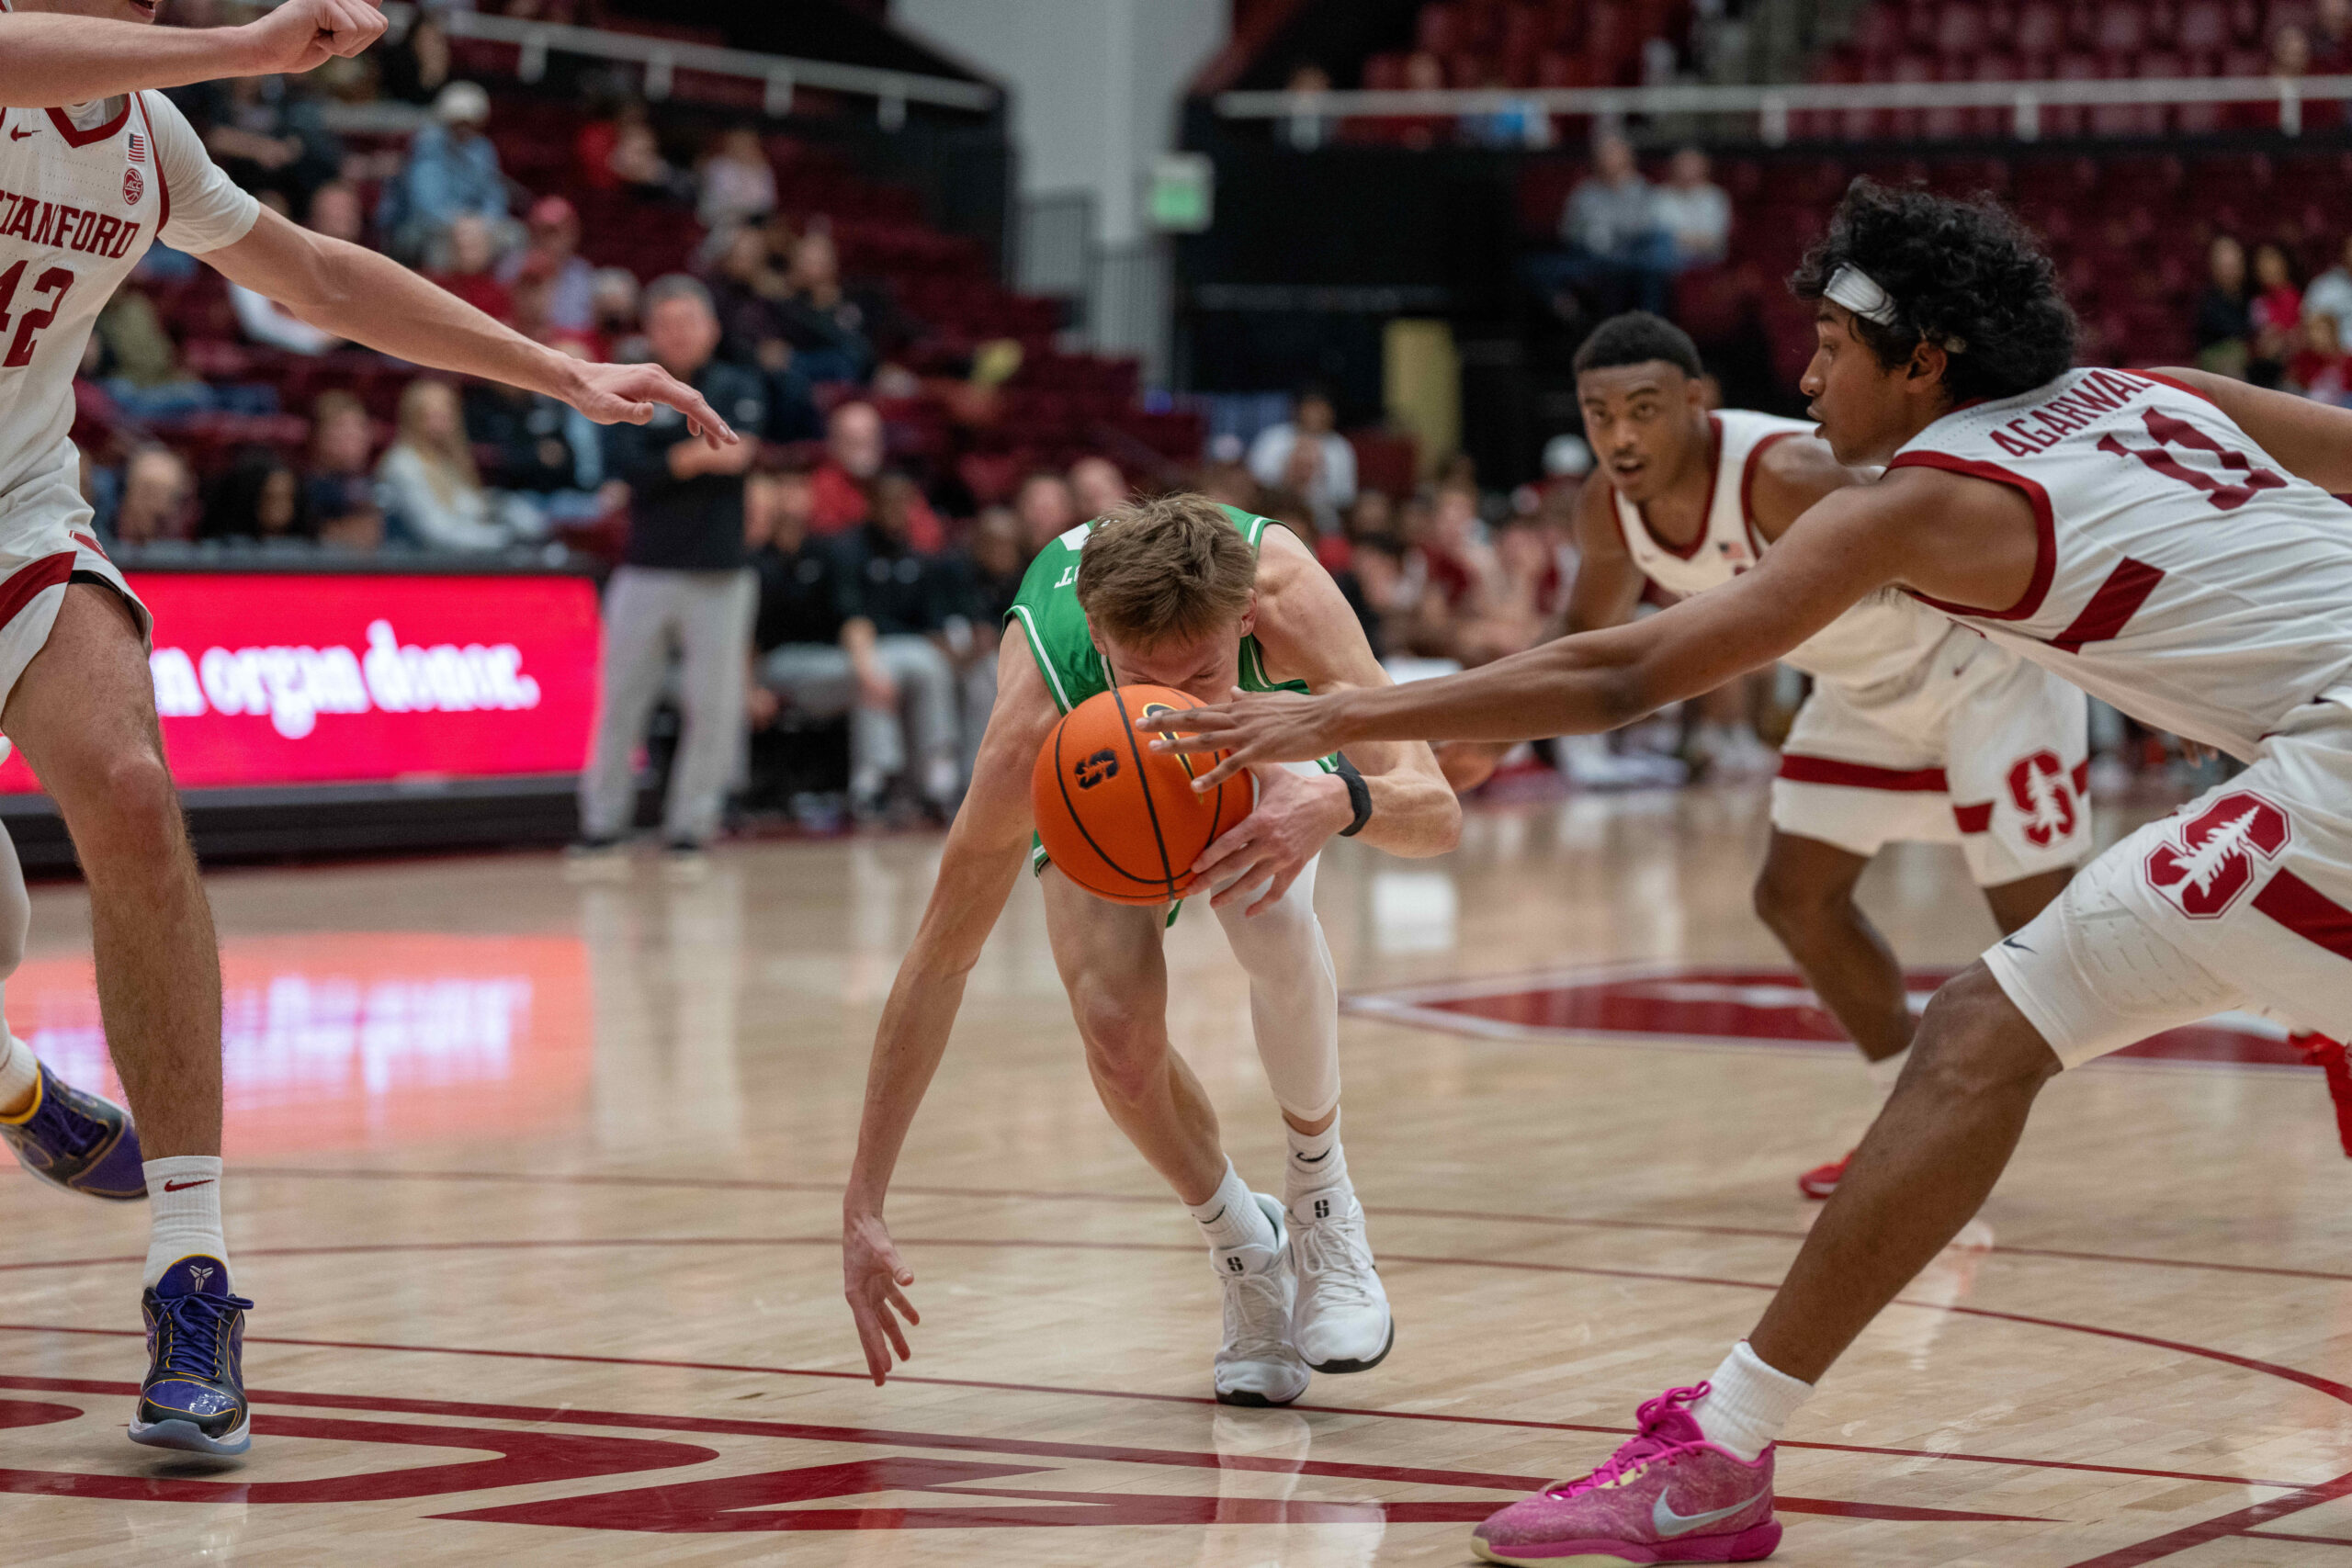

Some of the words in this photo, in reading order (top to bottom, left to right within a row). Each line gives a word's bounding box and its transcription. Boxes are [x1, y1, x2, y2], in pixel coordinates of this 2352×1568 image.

[0, 189, 141, 259] TANFORD
[1989, 369, 2155, 457] AGARWAL
[2097, 405, 2289, 511] 11
[199, 645, 371, 739] organ
[363, 617, 541, 714] donor.
